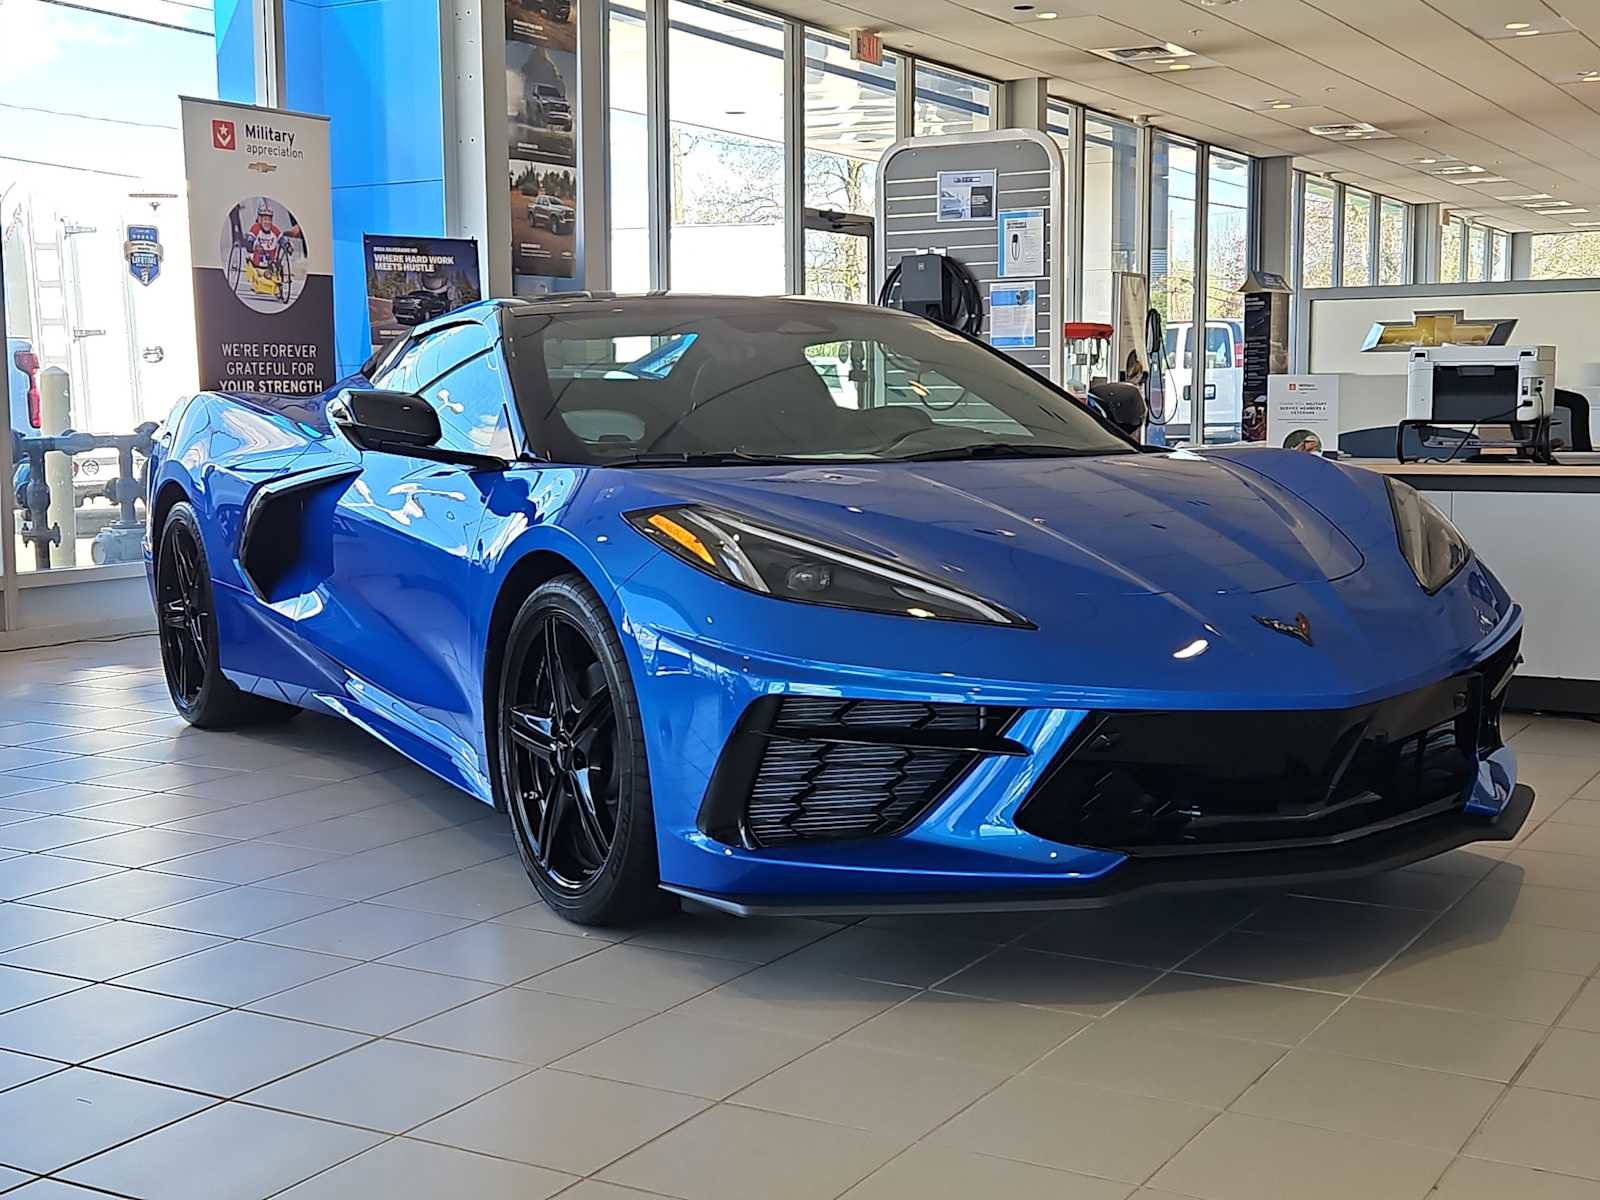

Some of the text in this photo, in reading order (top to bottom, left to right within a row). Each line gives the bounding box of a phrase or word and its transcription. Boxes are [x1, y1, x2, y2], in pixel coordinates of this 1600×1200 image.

[245, 124, 295, 145] Military
[246, 144, 304, 159] appreciation
[374, 254, 454, 265] WHERE HARD WORK
[375, 262, 435, 272] MEETS HUSTLE
[222, 343, 317, 358] WE'RE FOREVER
[226, 362, 315, 376] GRATEFUL FOR
[219, 380, 323, 393] YOUR STRENGTH
